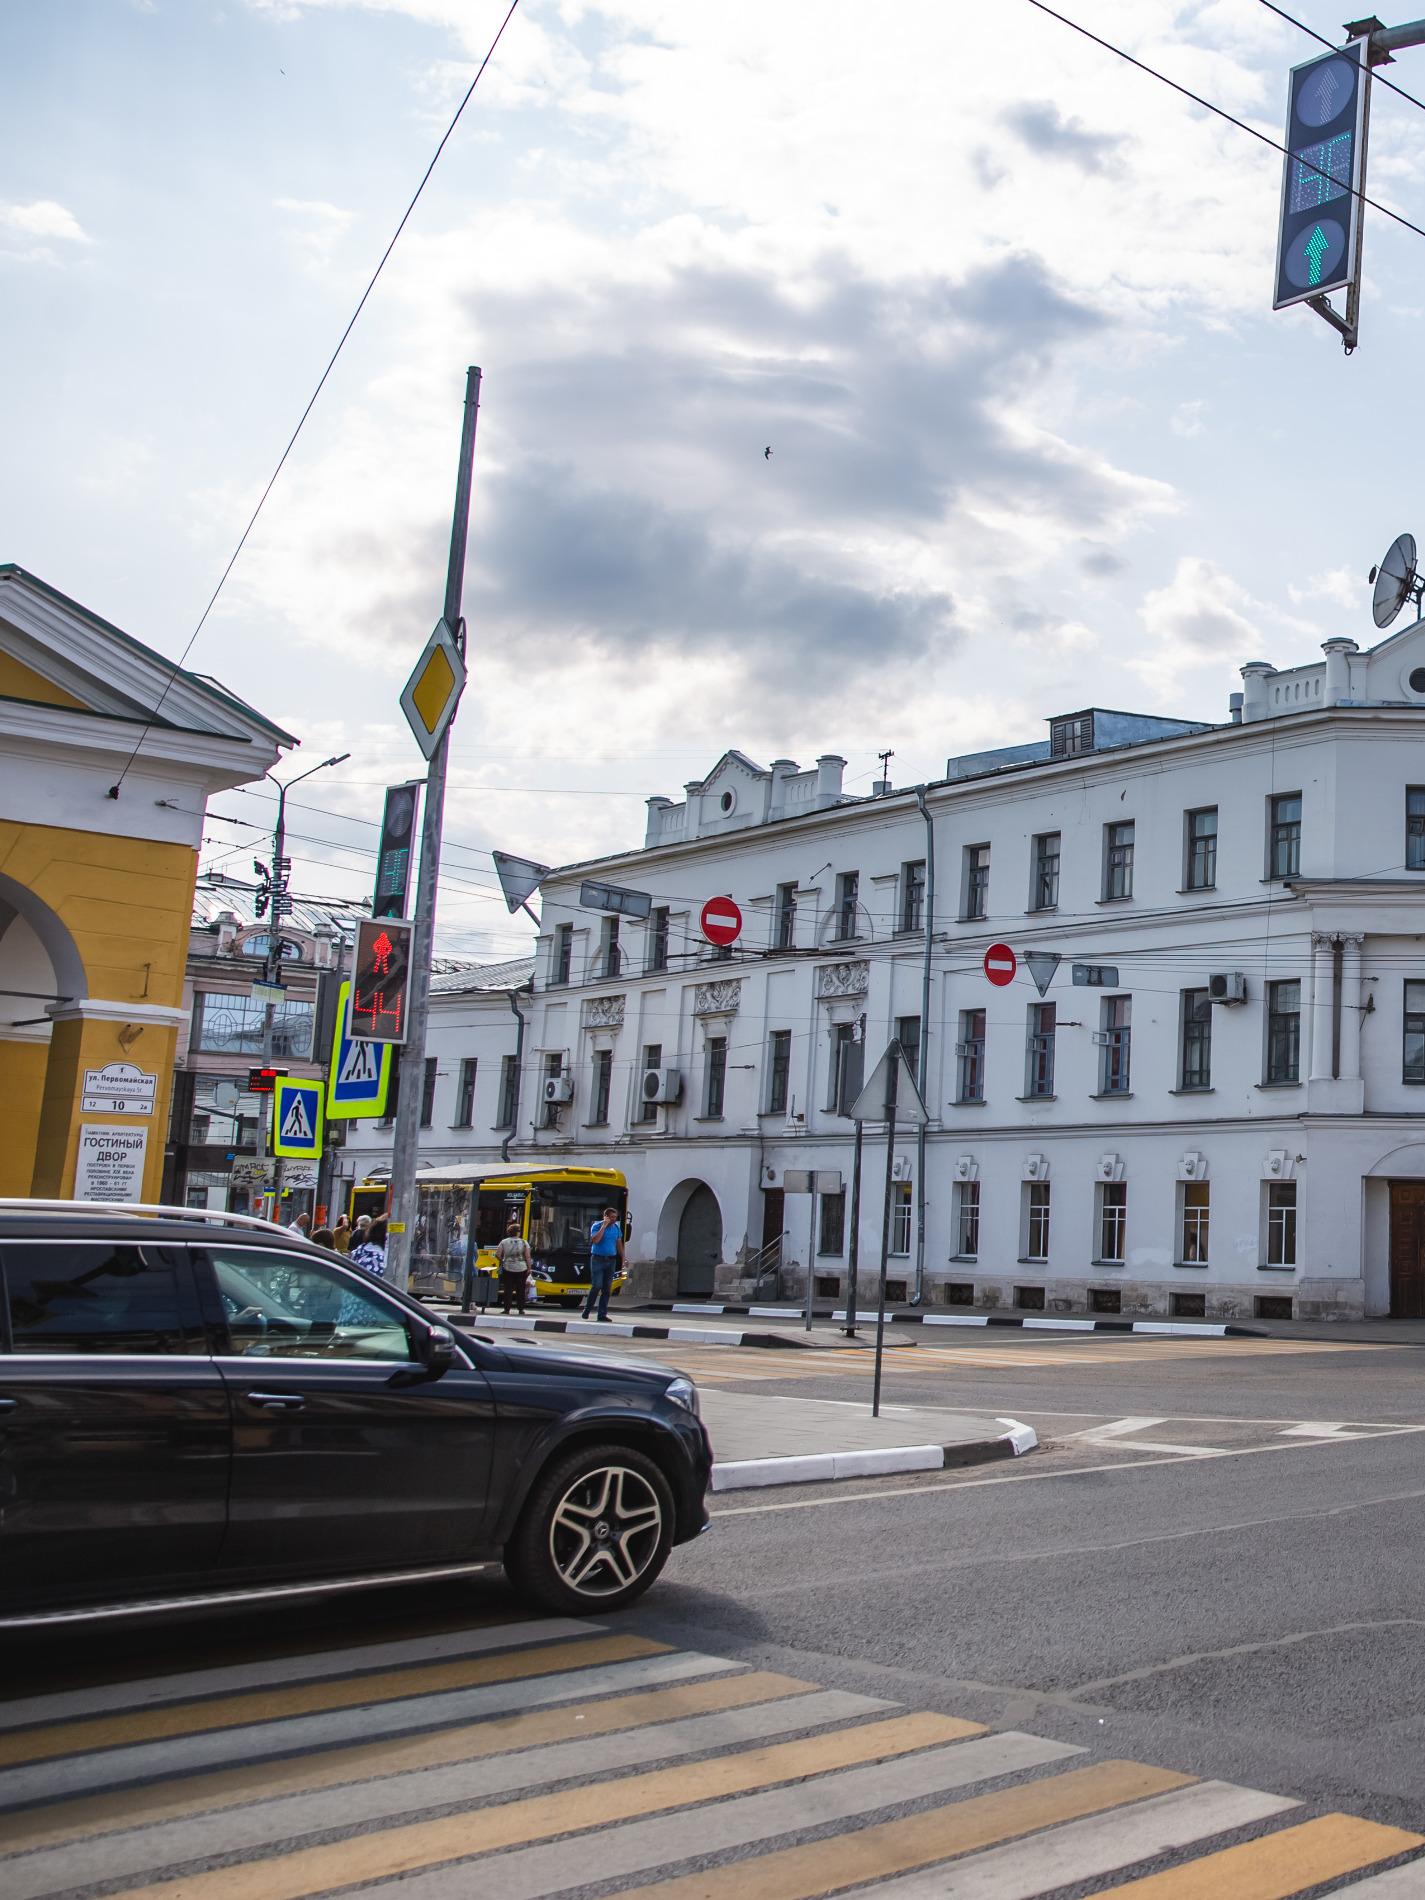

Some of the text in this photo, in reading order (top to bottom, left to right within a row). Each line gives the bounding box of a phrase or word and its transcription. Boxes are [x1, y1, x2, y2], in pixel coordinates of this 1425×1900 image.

[355, 989, 401, 1033] 44
[101, 1075, 153, 1085] Первомайская
[112, 1100, 125, 1111] 10
[84, 1137, 144, 1149] ГОСТИНЫЙ
[97, 1151, 128, 1162] ДВОР
